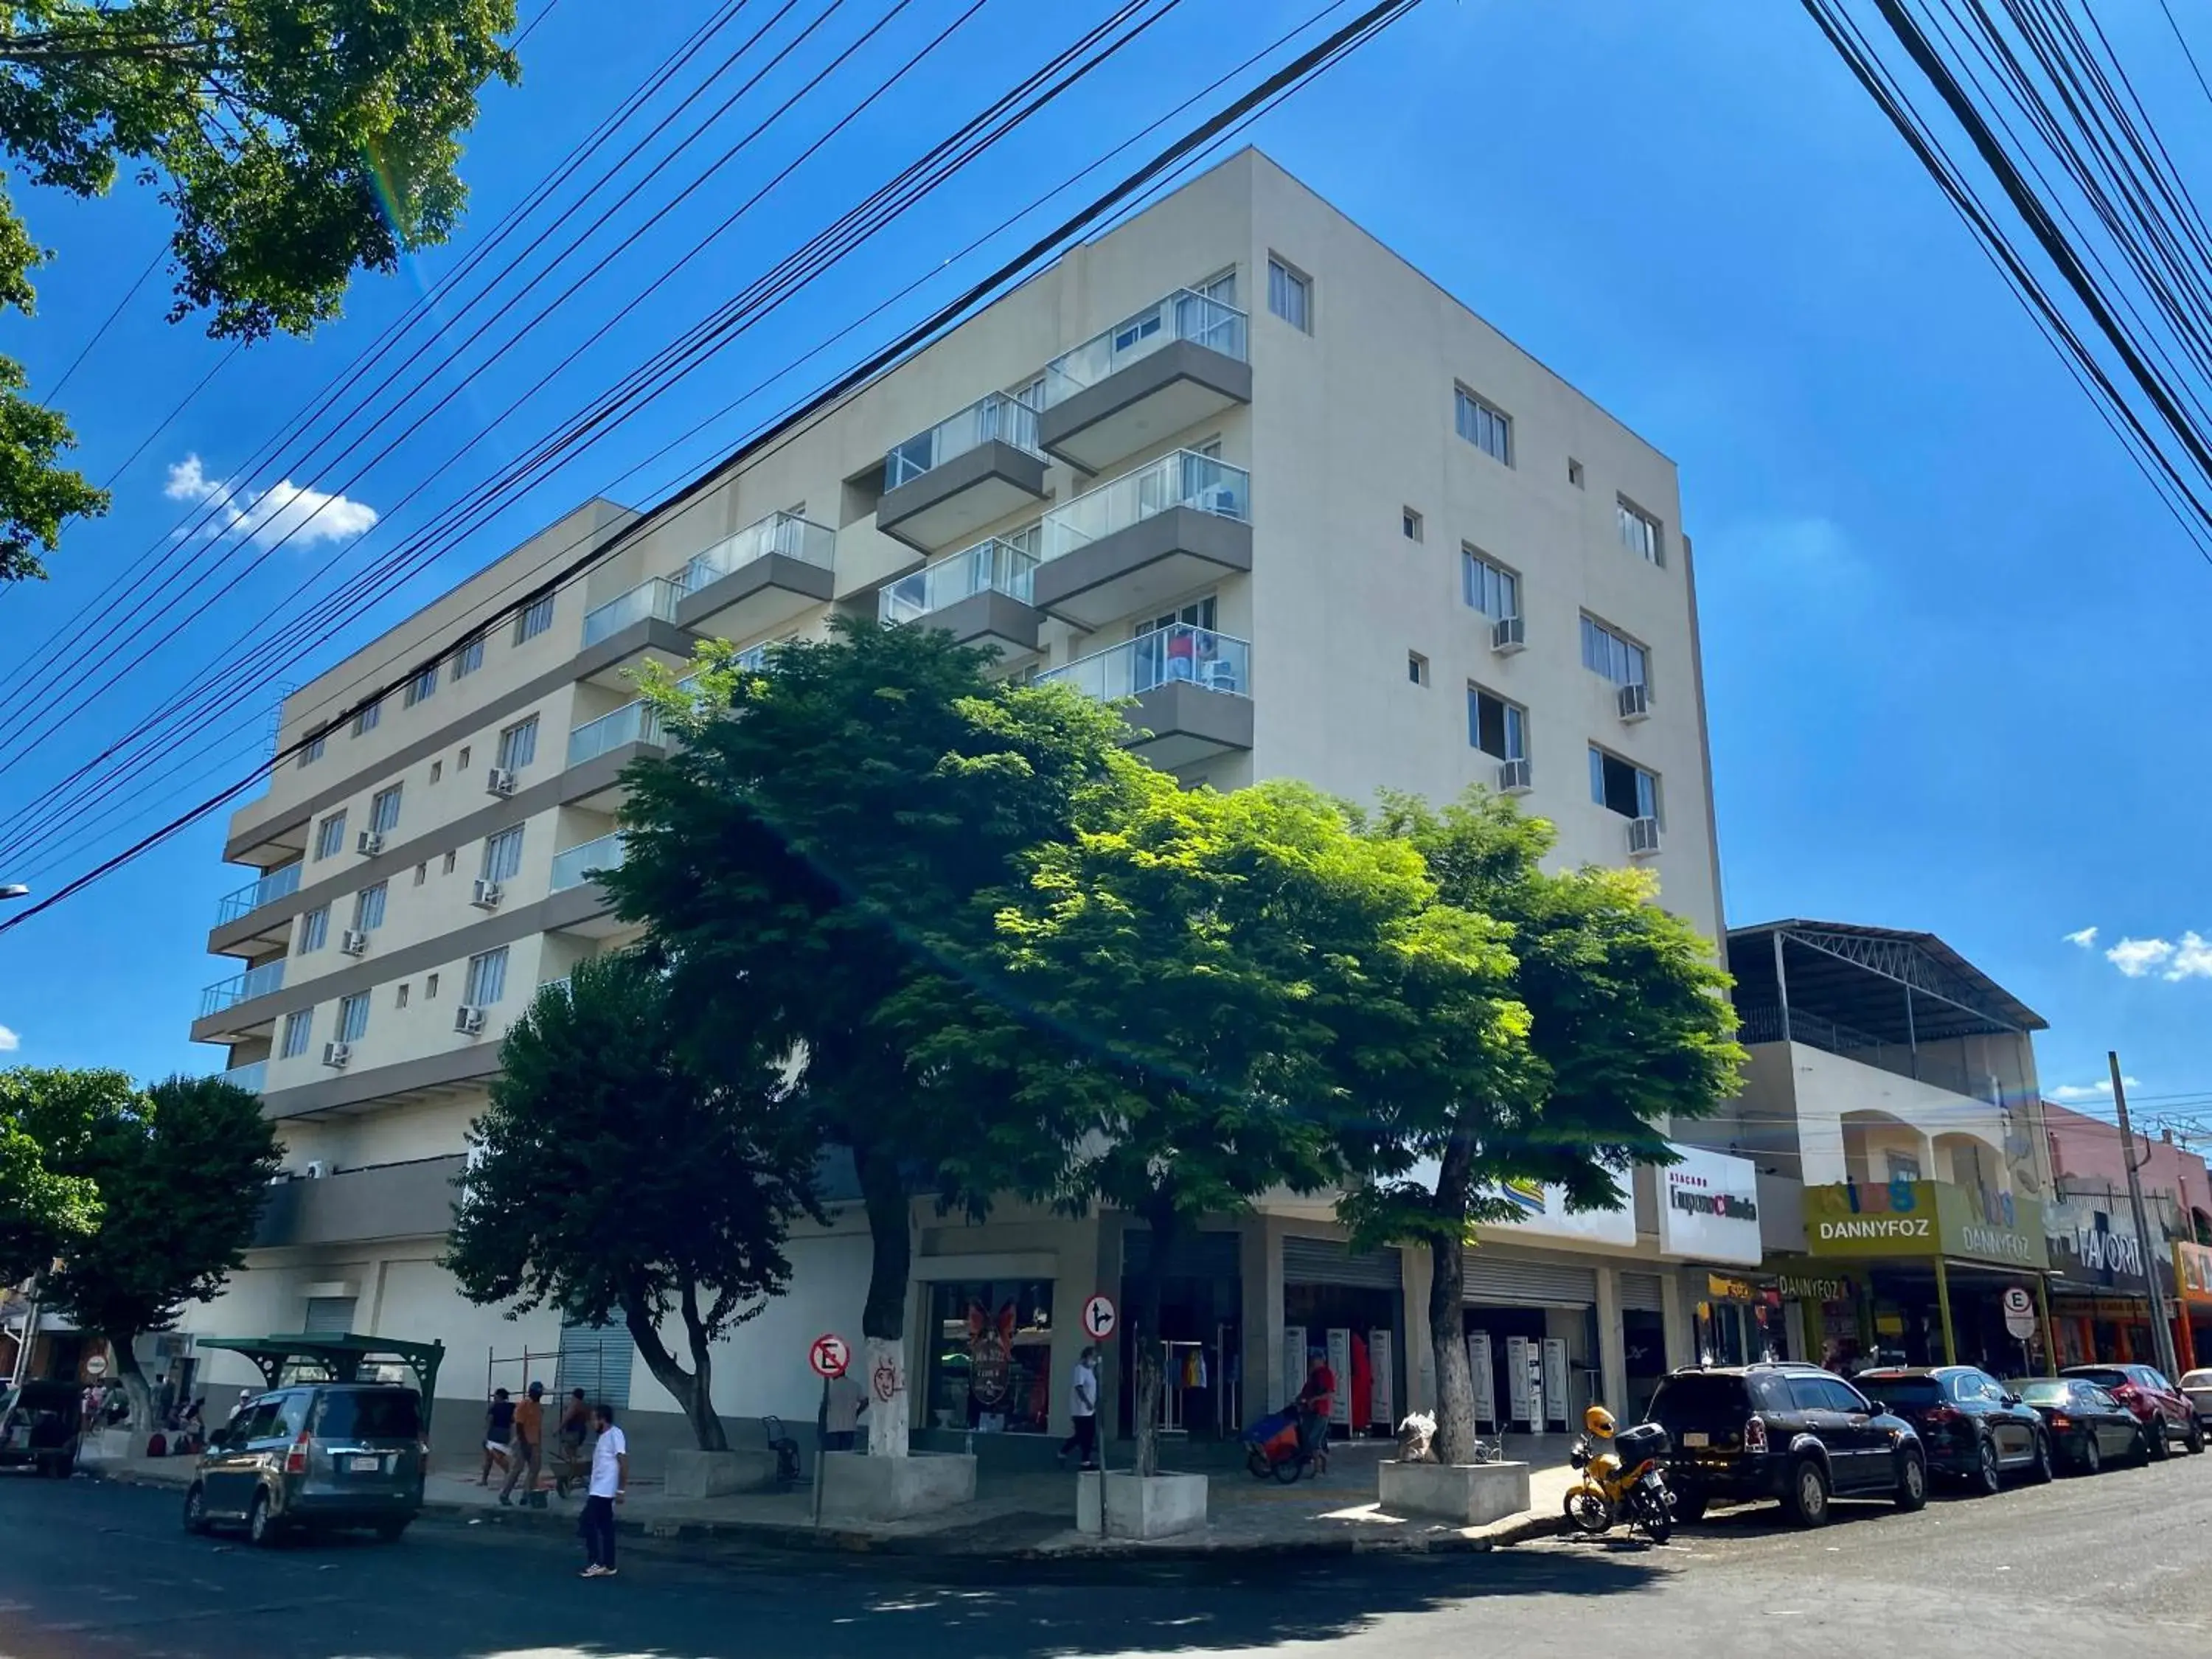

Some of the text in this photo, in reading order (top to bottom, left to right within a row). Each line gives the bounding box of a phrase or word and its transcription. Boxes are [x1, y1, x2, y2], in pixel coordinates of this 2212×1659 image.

[1669, 1172, 1707, 1188] ATACADO
[1820, 1218, 1930, 1239] DANNYFOZ
[1962, 1226, 2031, 1262] DANNYFOZ
[1779, 1275, 1840, 1301] DANNYFOZ
[2011, 1291, 2024, 1307] E
[821, 1343, 838, 1369] E
